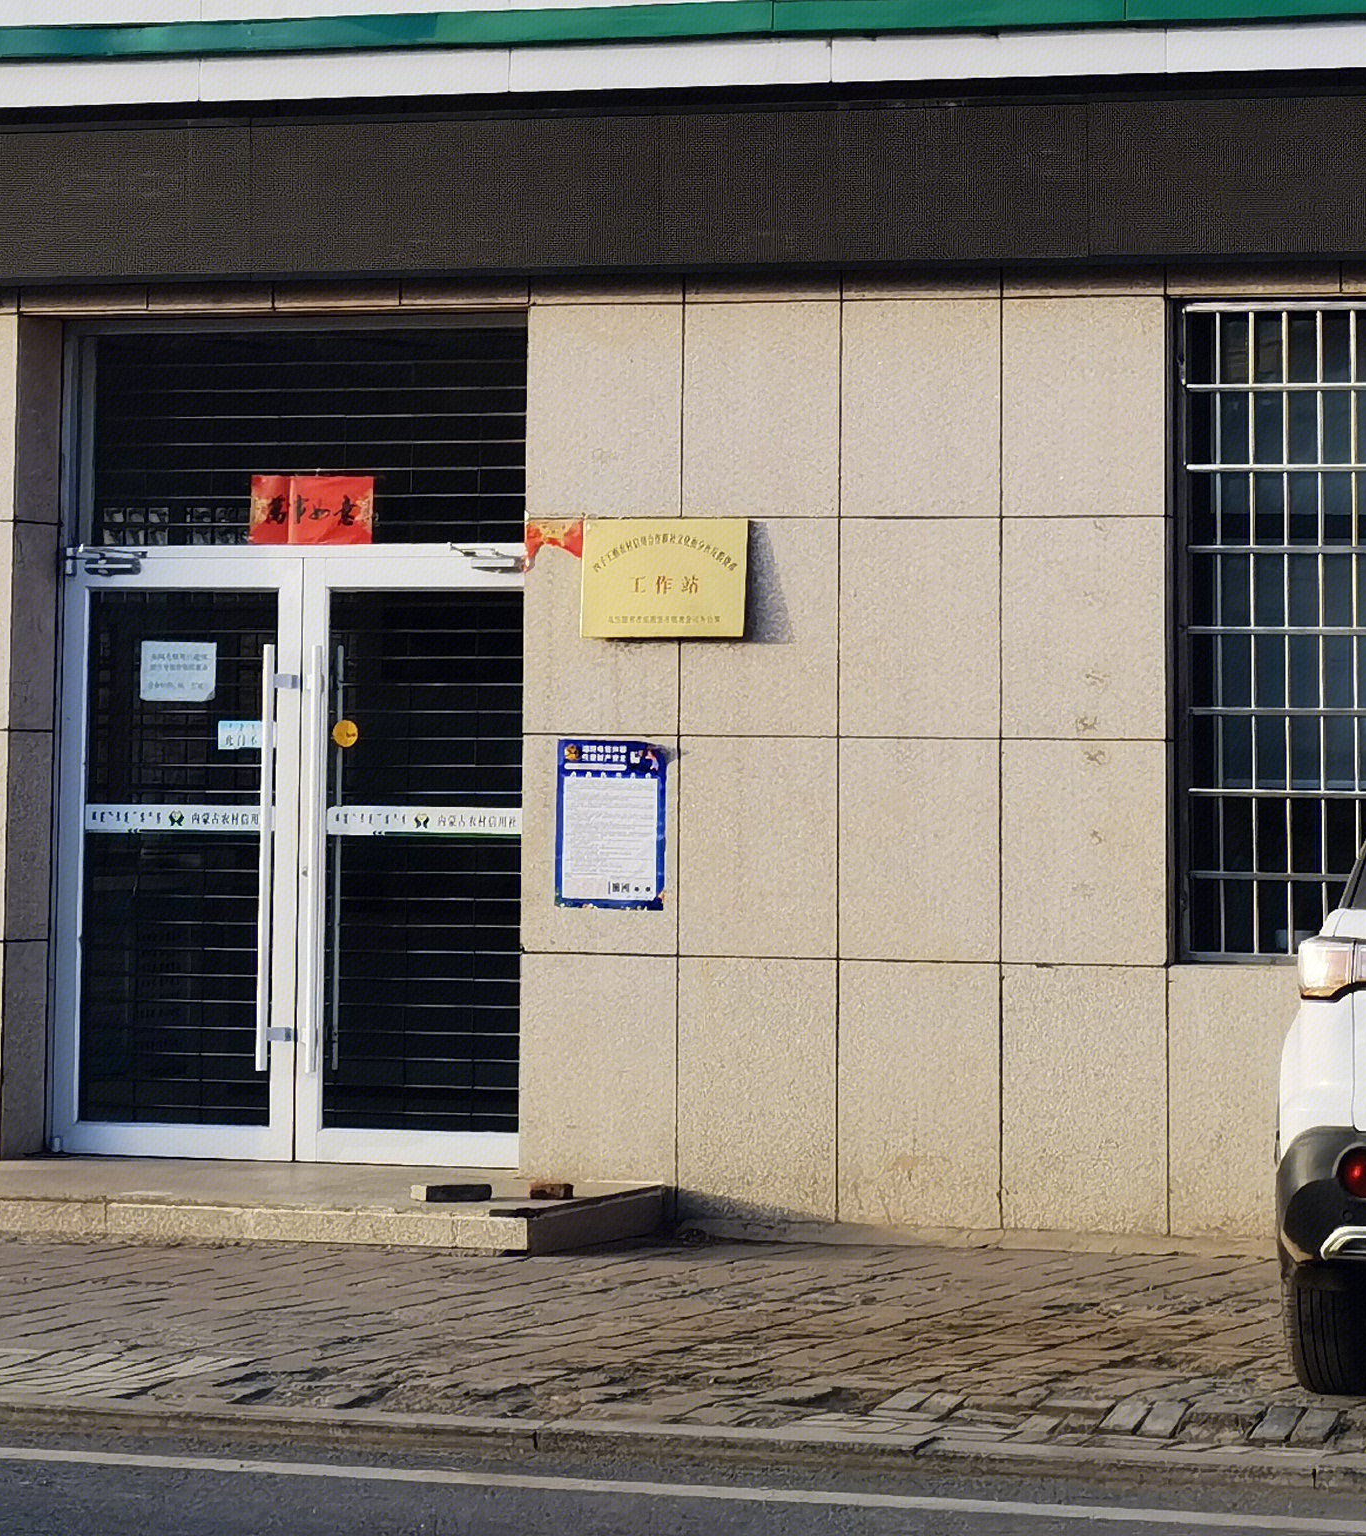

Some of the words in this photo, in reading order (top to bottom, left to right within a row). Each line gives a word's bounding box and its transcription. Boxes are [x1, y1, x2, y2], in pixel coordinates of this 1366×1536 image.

[630, 573, 700, 595] 工作站
[437, 815, 517, 828] 内蒙古农村信用社
